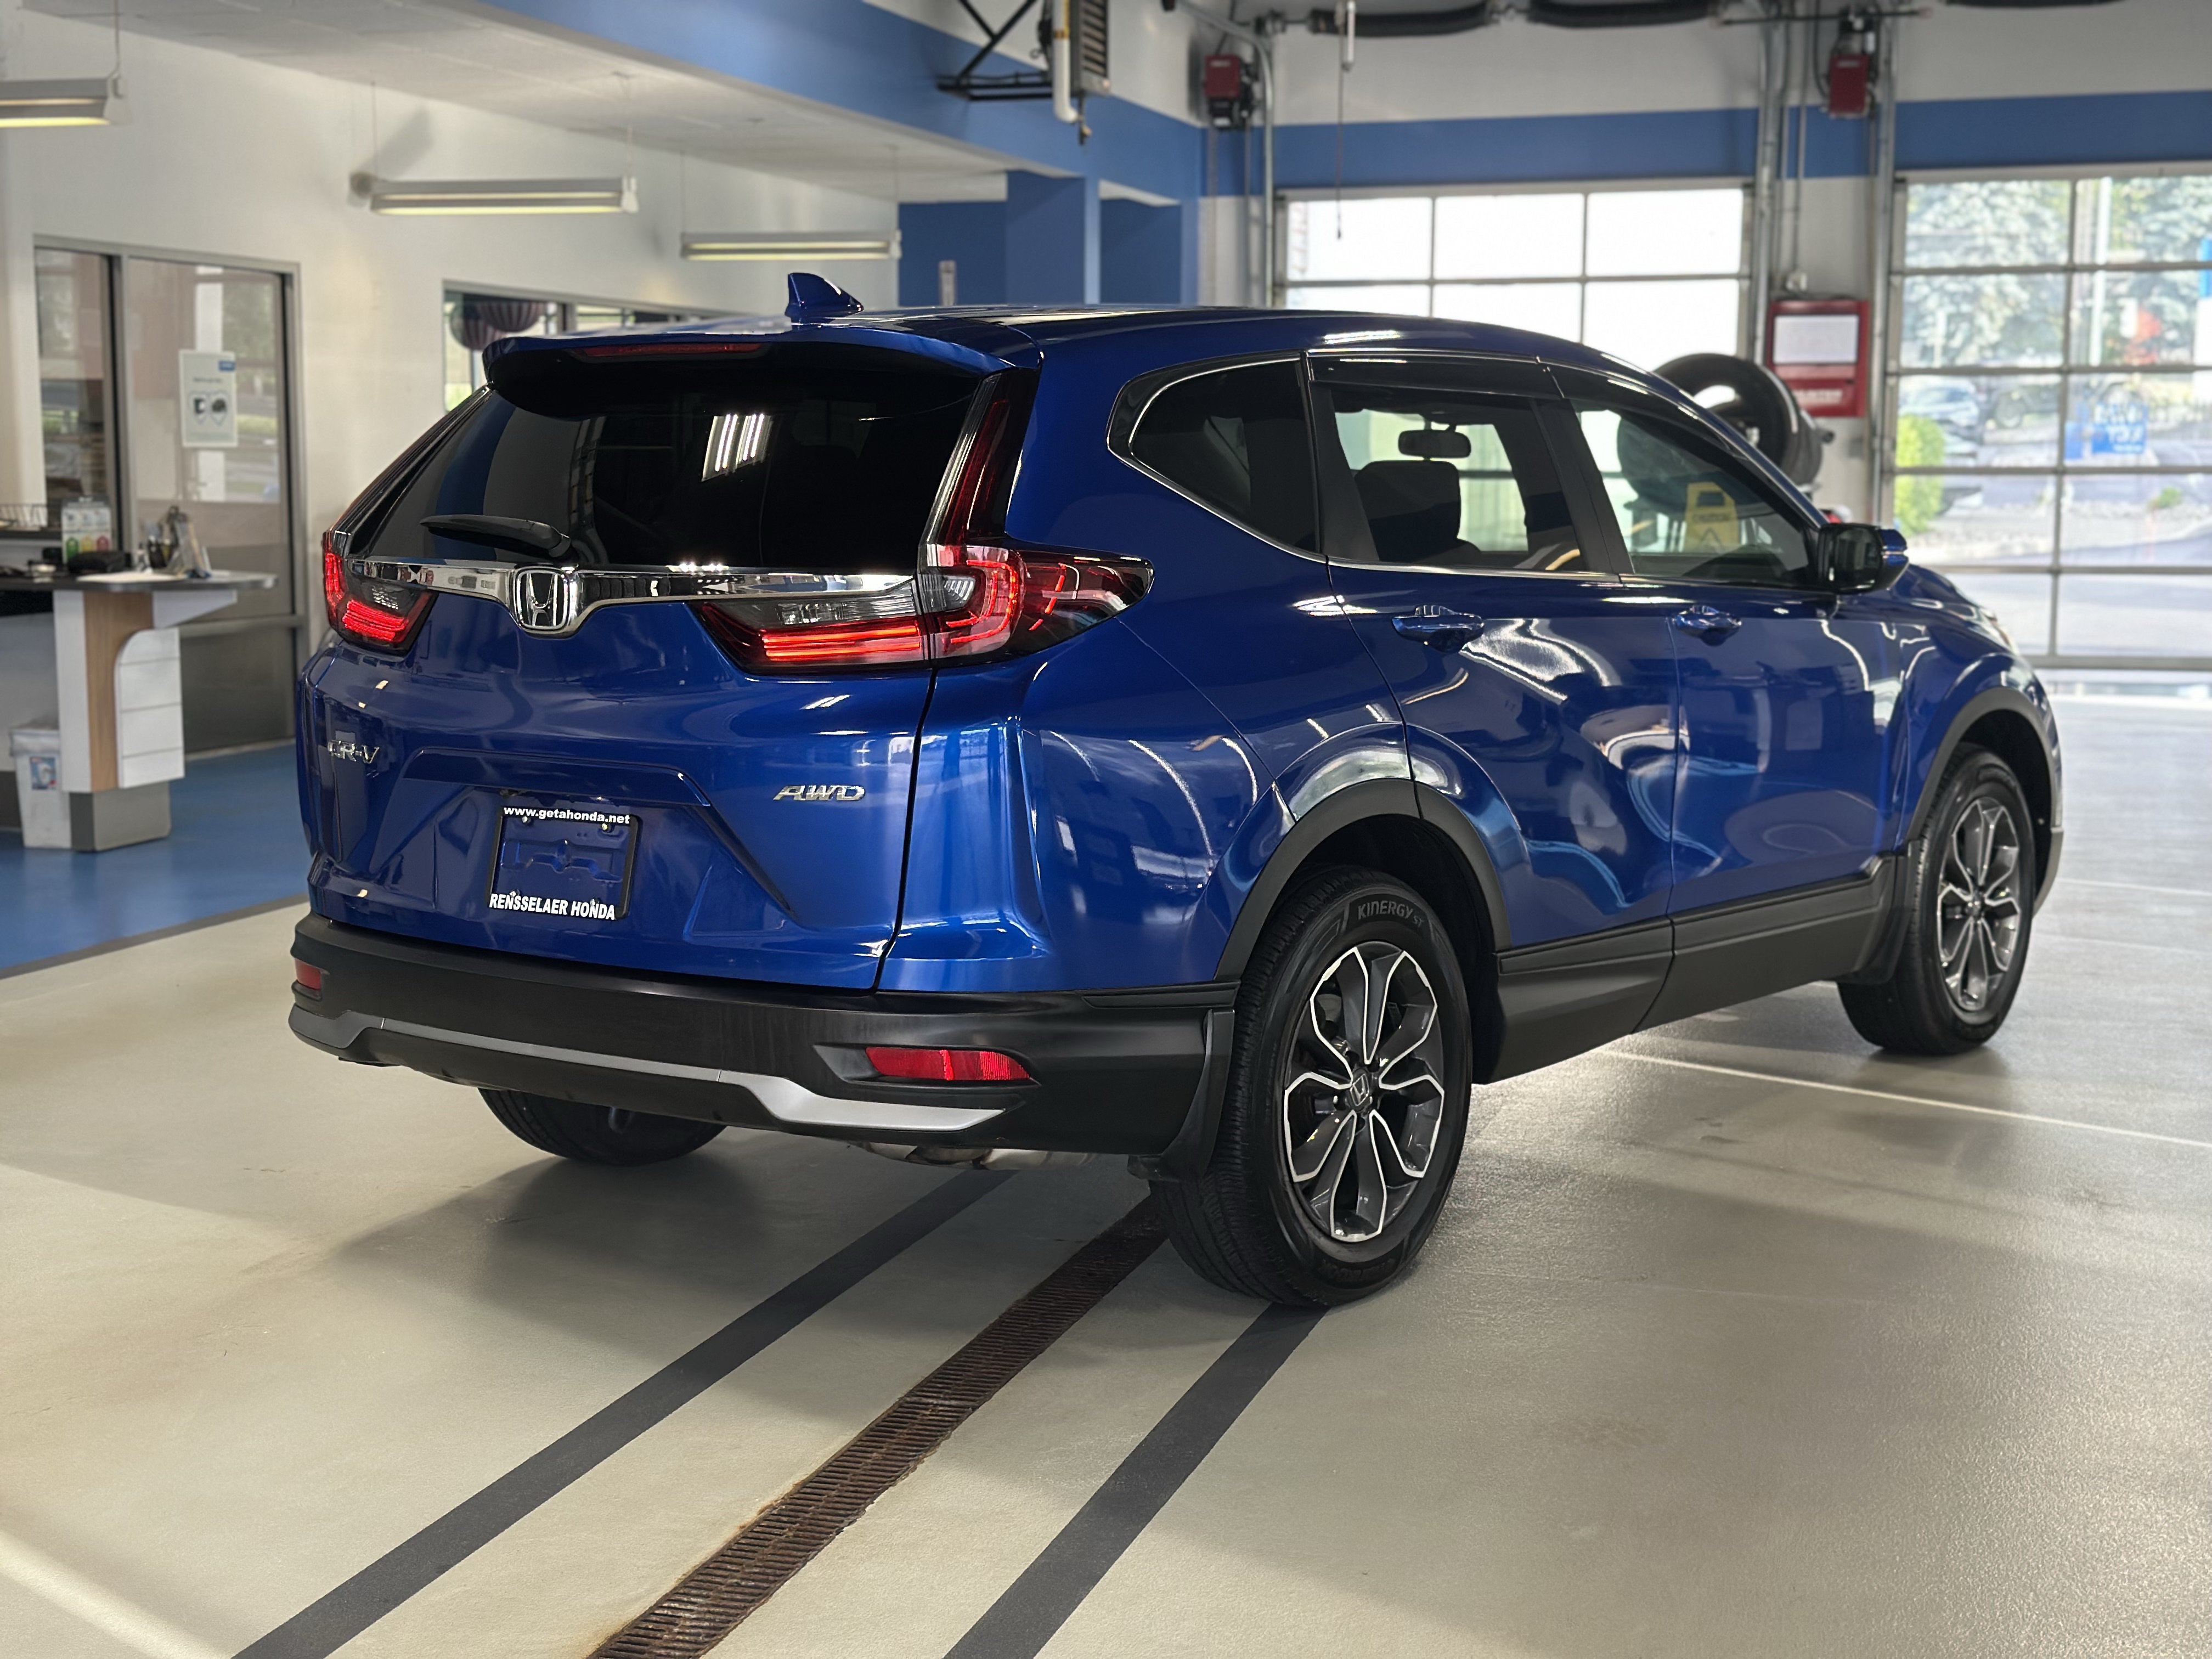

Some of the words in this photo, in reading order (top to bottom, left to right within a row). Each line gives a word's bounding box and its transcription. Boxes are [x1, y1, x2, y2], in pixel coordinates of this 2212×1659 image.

[327, 740, 380, 764] CR-V
[773, 785, 865, 801] AWD
[504, 807, 630, 824] www.getahonda.net
[489, 893, 568, 915] RENSSELAER
[570, 901, 615, 920] HONDA
[1358, 900, 1414, 920] KINERGY
